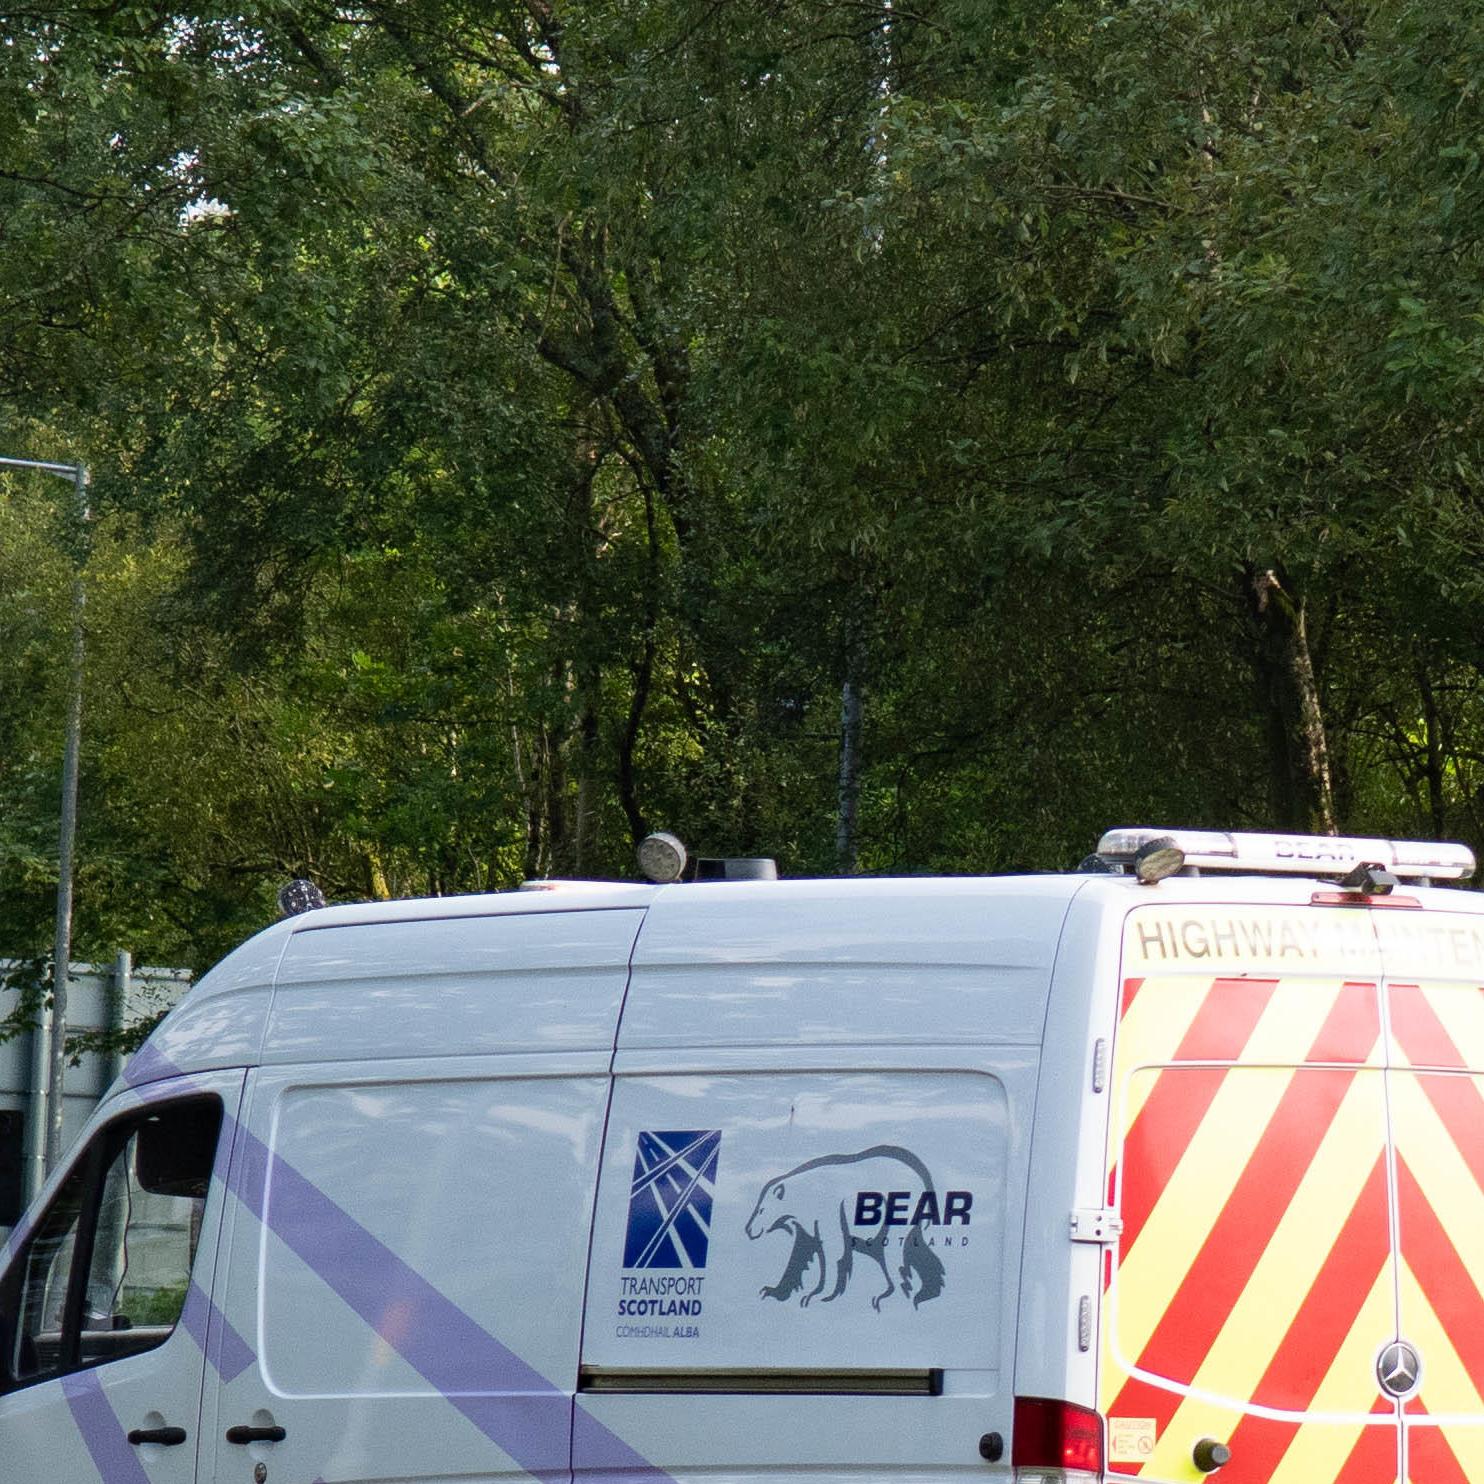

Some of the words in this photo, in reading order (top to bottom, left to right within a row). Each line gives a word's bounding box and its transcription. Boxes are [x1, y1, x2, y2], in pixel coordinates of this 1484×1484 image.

[1135, 919, 1321, 960] HIGHWAY
[853, 1191, 973, 1226] BEAR
[850, 1236, 969, 1248] SCOTLAND
[620, 1276, 705, 1296] TRANSPORT
[617, 1299, 703, 1316] SCOTLAND
[672, 1326, 700, 1338] ALBA
